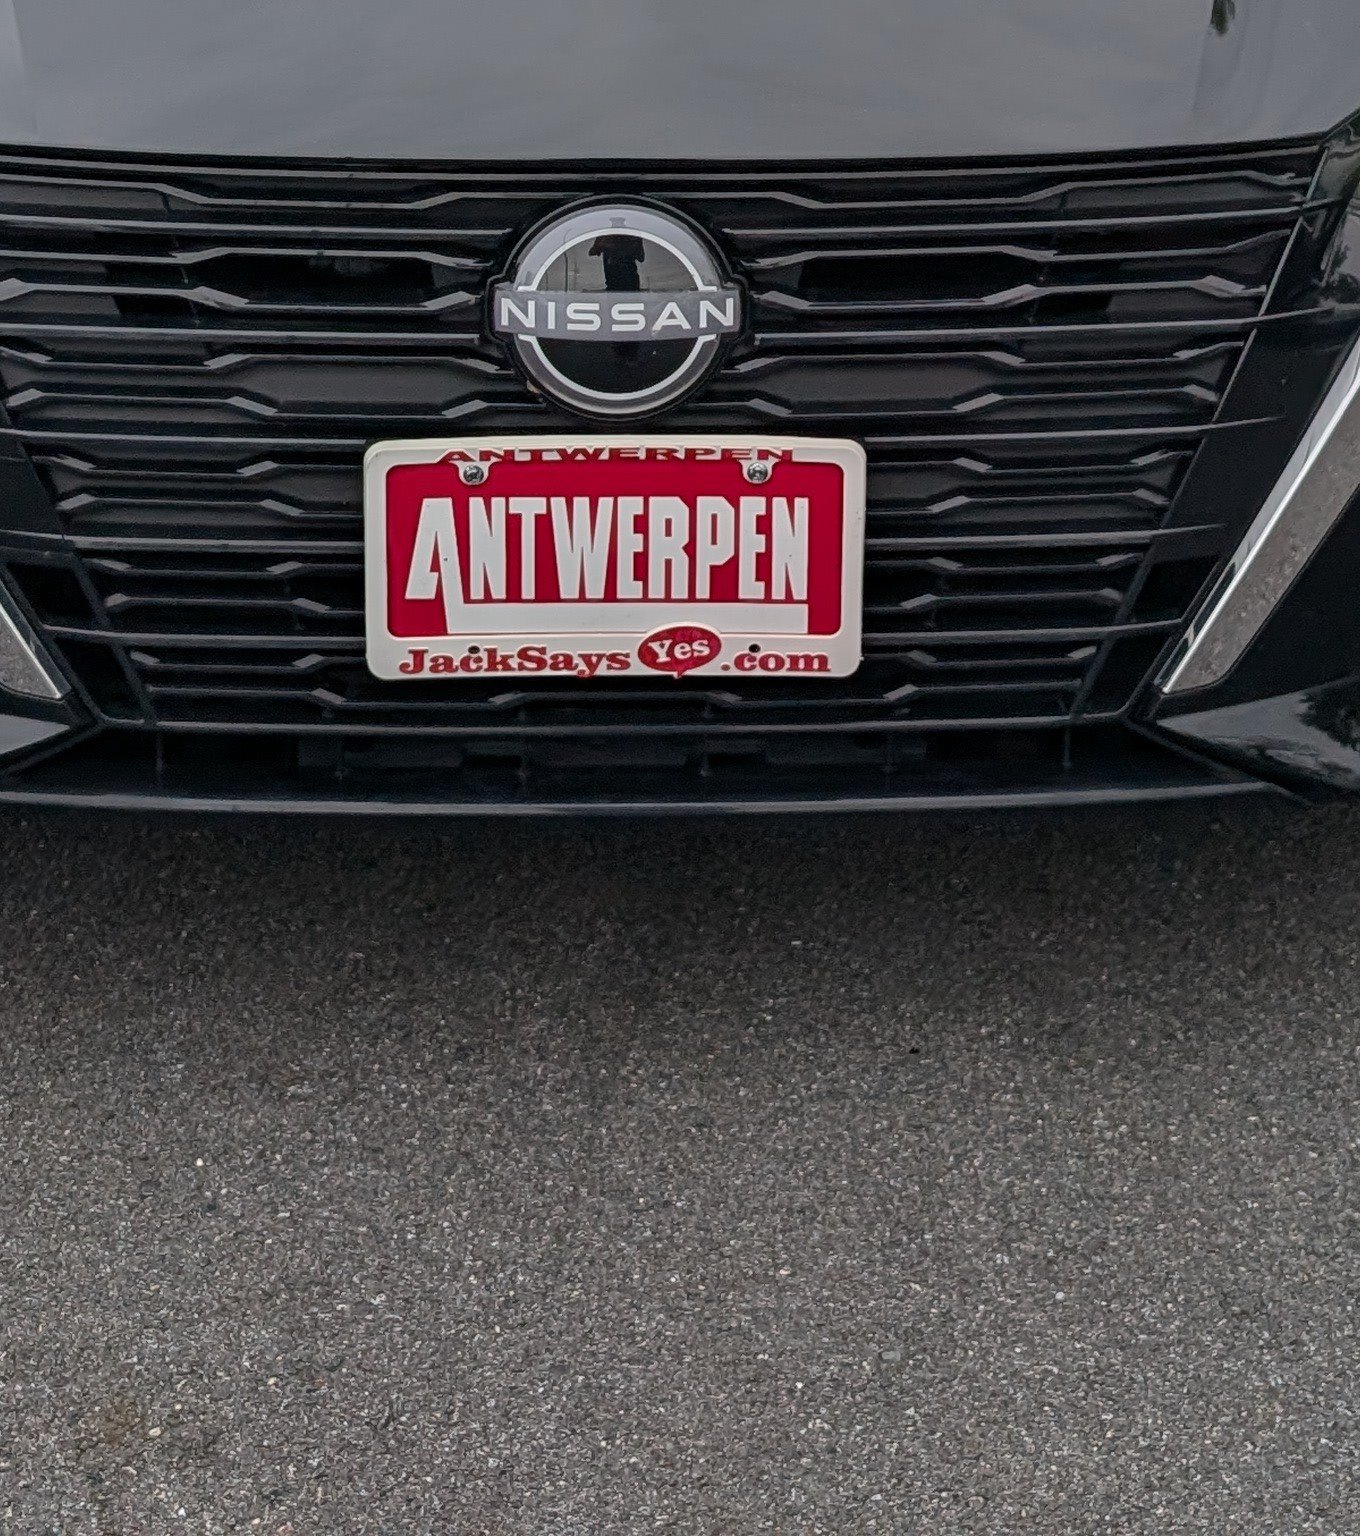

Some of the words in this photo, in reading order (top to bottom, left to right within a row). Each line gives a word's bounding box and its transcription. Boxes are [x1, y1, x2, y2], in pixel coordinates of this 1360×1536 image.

[500, 296, 735, 332] NISSAN
[436, 446, 794, 463] ANTWERPEN
[405, 496, 809, 601] ANTWERPEN
[647, 639, 712, 664] Yes
